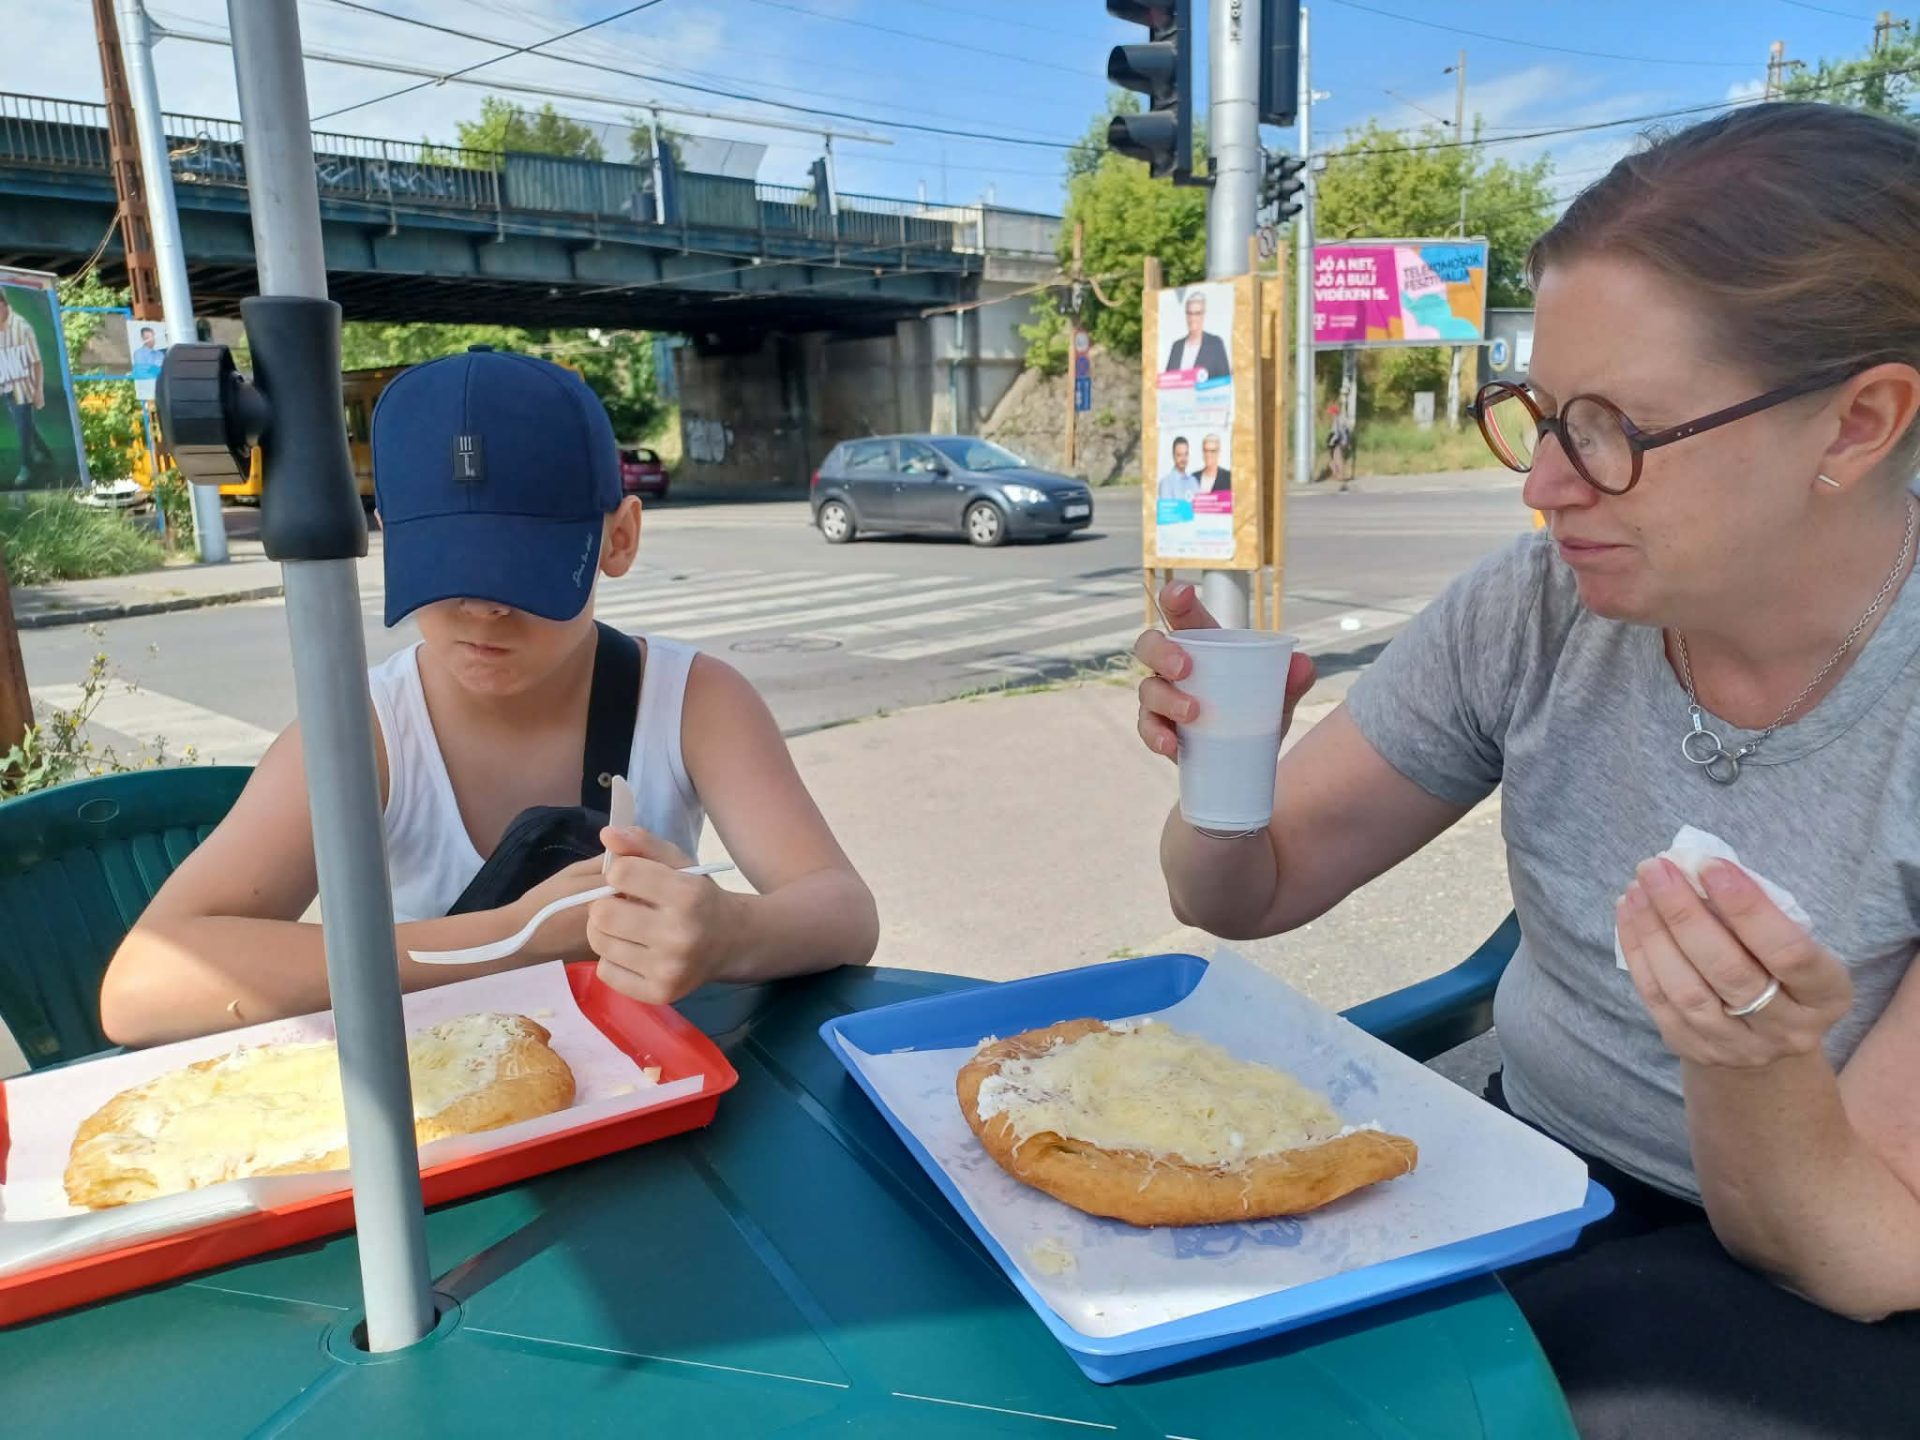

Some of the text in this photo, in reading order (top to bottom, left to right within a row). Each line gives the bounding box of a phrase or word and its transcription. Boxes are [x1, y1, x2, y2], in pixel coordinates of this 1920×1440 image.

[1316, 255, 1335, 271] JÓ
[1336, 257, 1346, 271] A
[1315, 271, 1376, 287] JÓ A BULI
[1314, 286, 1371, 301] VIDÉKEN
